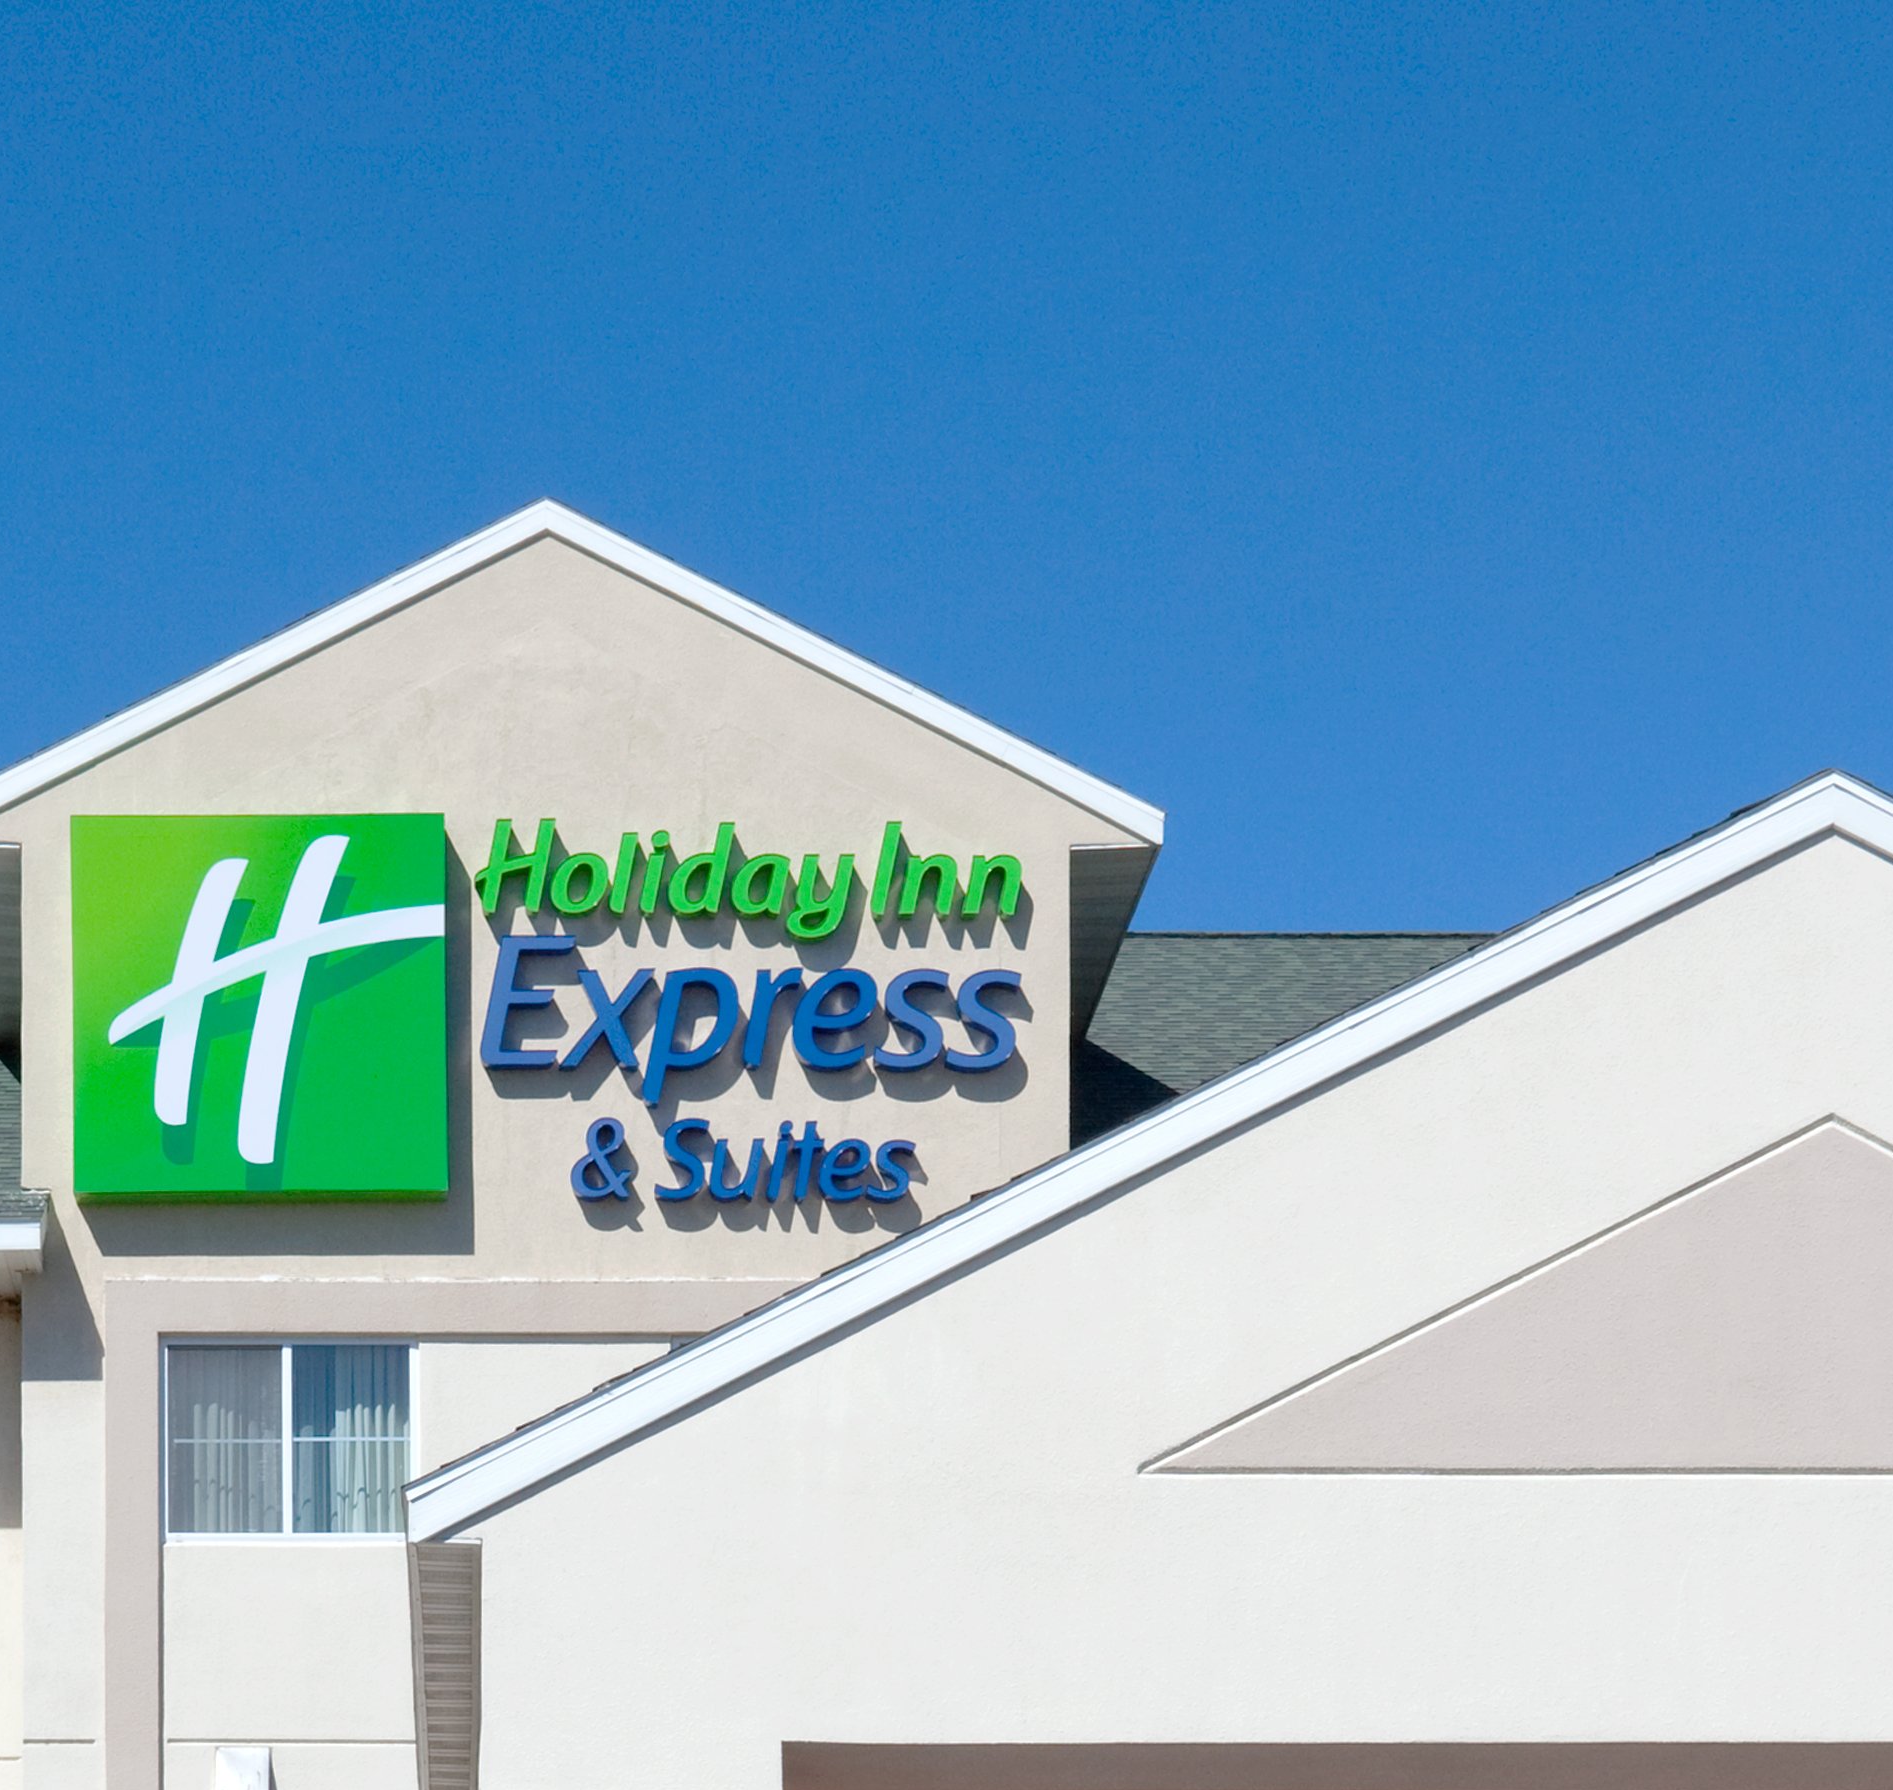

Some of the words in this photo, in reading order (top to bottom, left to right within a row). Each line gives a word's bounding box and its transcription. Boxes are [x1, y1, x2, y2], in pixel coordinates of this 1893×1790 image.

[474, 818, 856, 942] Holiday
[870, 820, 1023, 919] Inn
[107, 834, 446, 1166] H
[480, 932, 1022, 1107] Express
[571, 1117, 633, 1201] &
[654, 1118, 916, 1202] Suites
